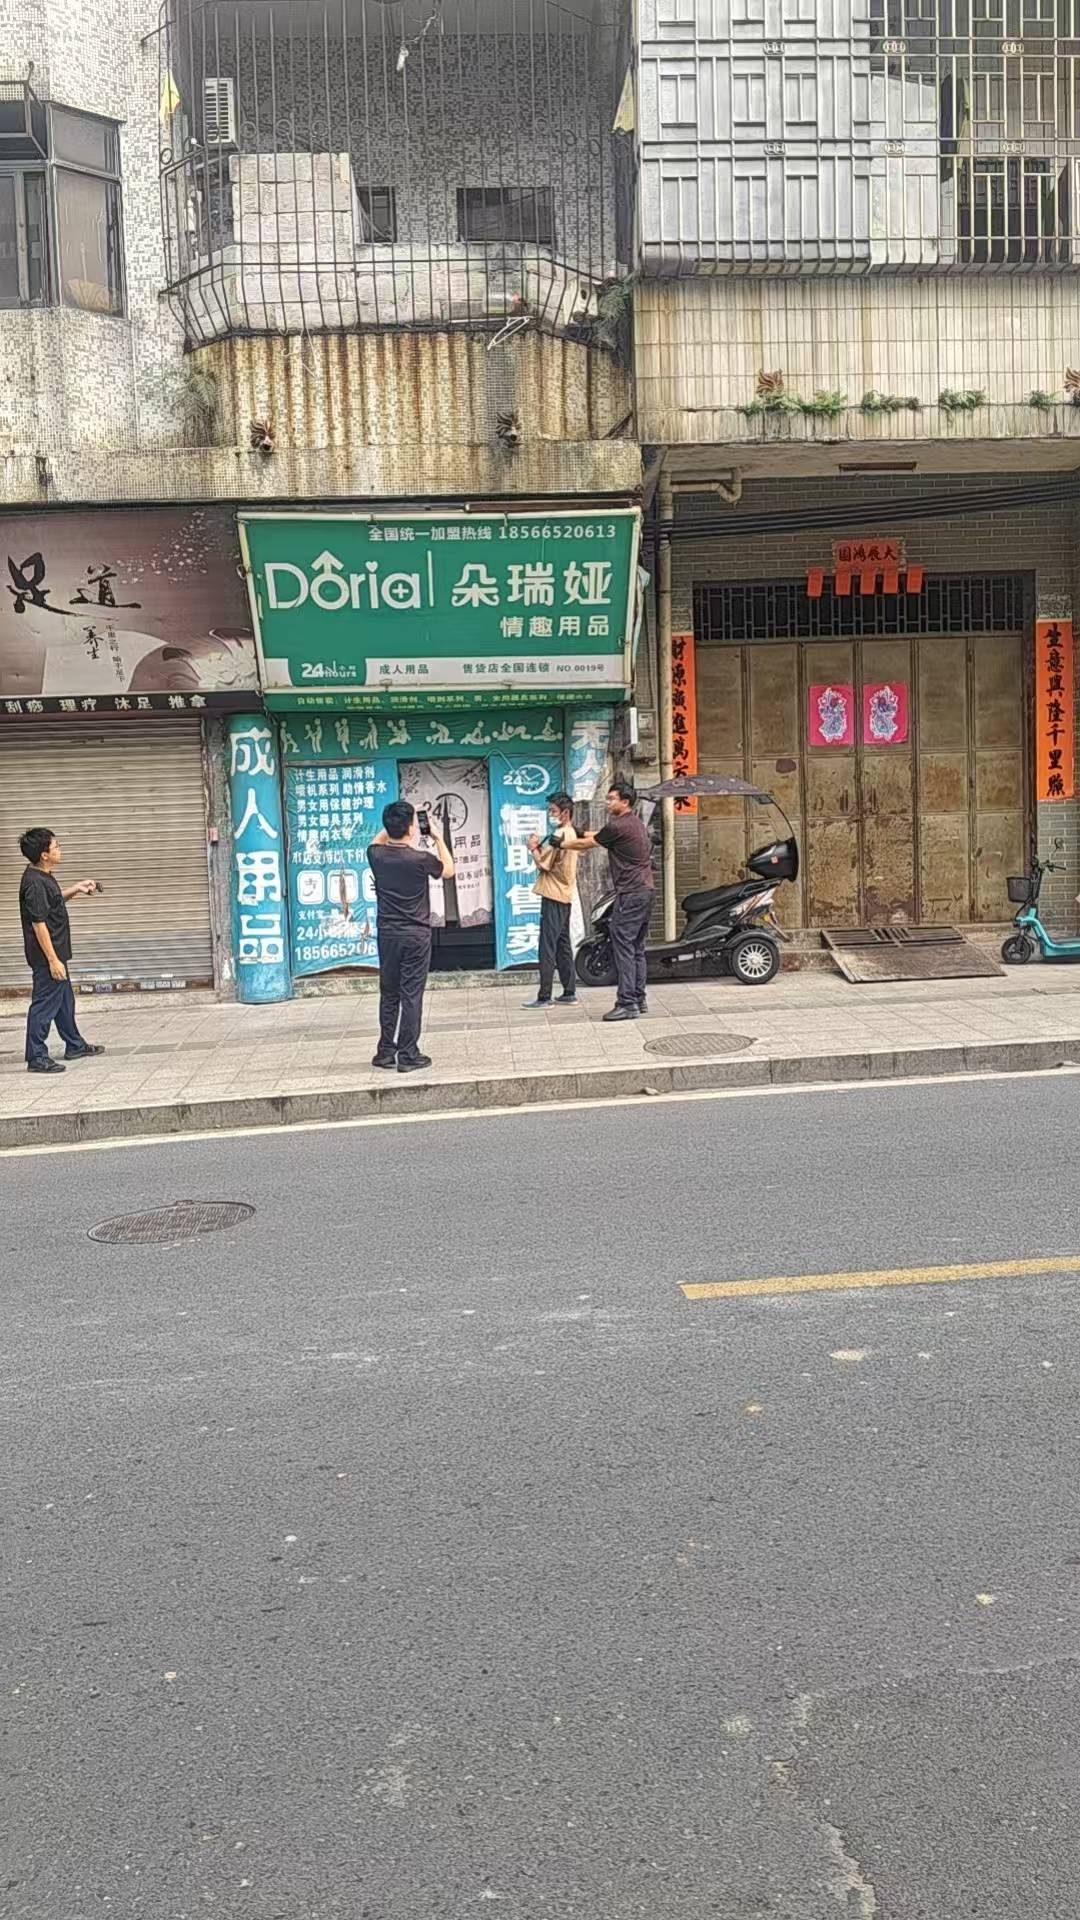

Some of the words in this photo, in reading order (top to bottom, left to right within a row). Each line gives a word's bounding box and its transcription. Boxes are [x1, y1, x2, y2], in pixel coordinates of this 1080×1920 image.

[368, 527, 492, 541] 全国统一加盟热线
[499, 525, 616, 539] 18566520613
[451, 560, 613, 608] 朵瑞娅
[501, 615, 610, 638] 情趣用品
[379, 664, 430, 675] 成人用品
[462, 662, 549, 674] 售货店全国连锁
[5, 699, 44, 713] 刮痧
[59, 698, 97, 712] 理疗
[115, 696, 153, 710] 沐足
[168, 695, 207, 709] 推拿
[295, 768, 338, 781] 计生用品
[342, 766, 375, 780] 润滑剂
[342, 780, 387, 795] 助情香水
[297, 796, 374, 812] 男女用保健护理
[230, 728, 284, 964] 成人用品
[292, 847, 370, 865] 本店支持以下付
